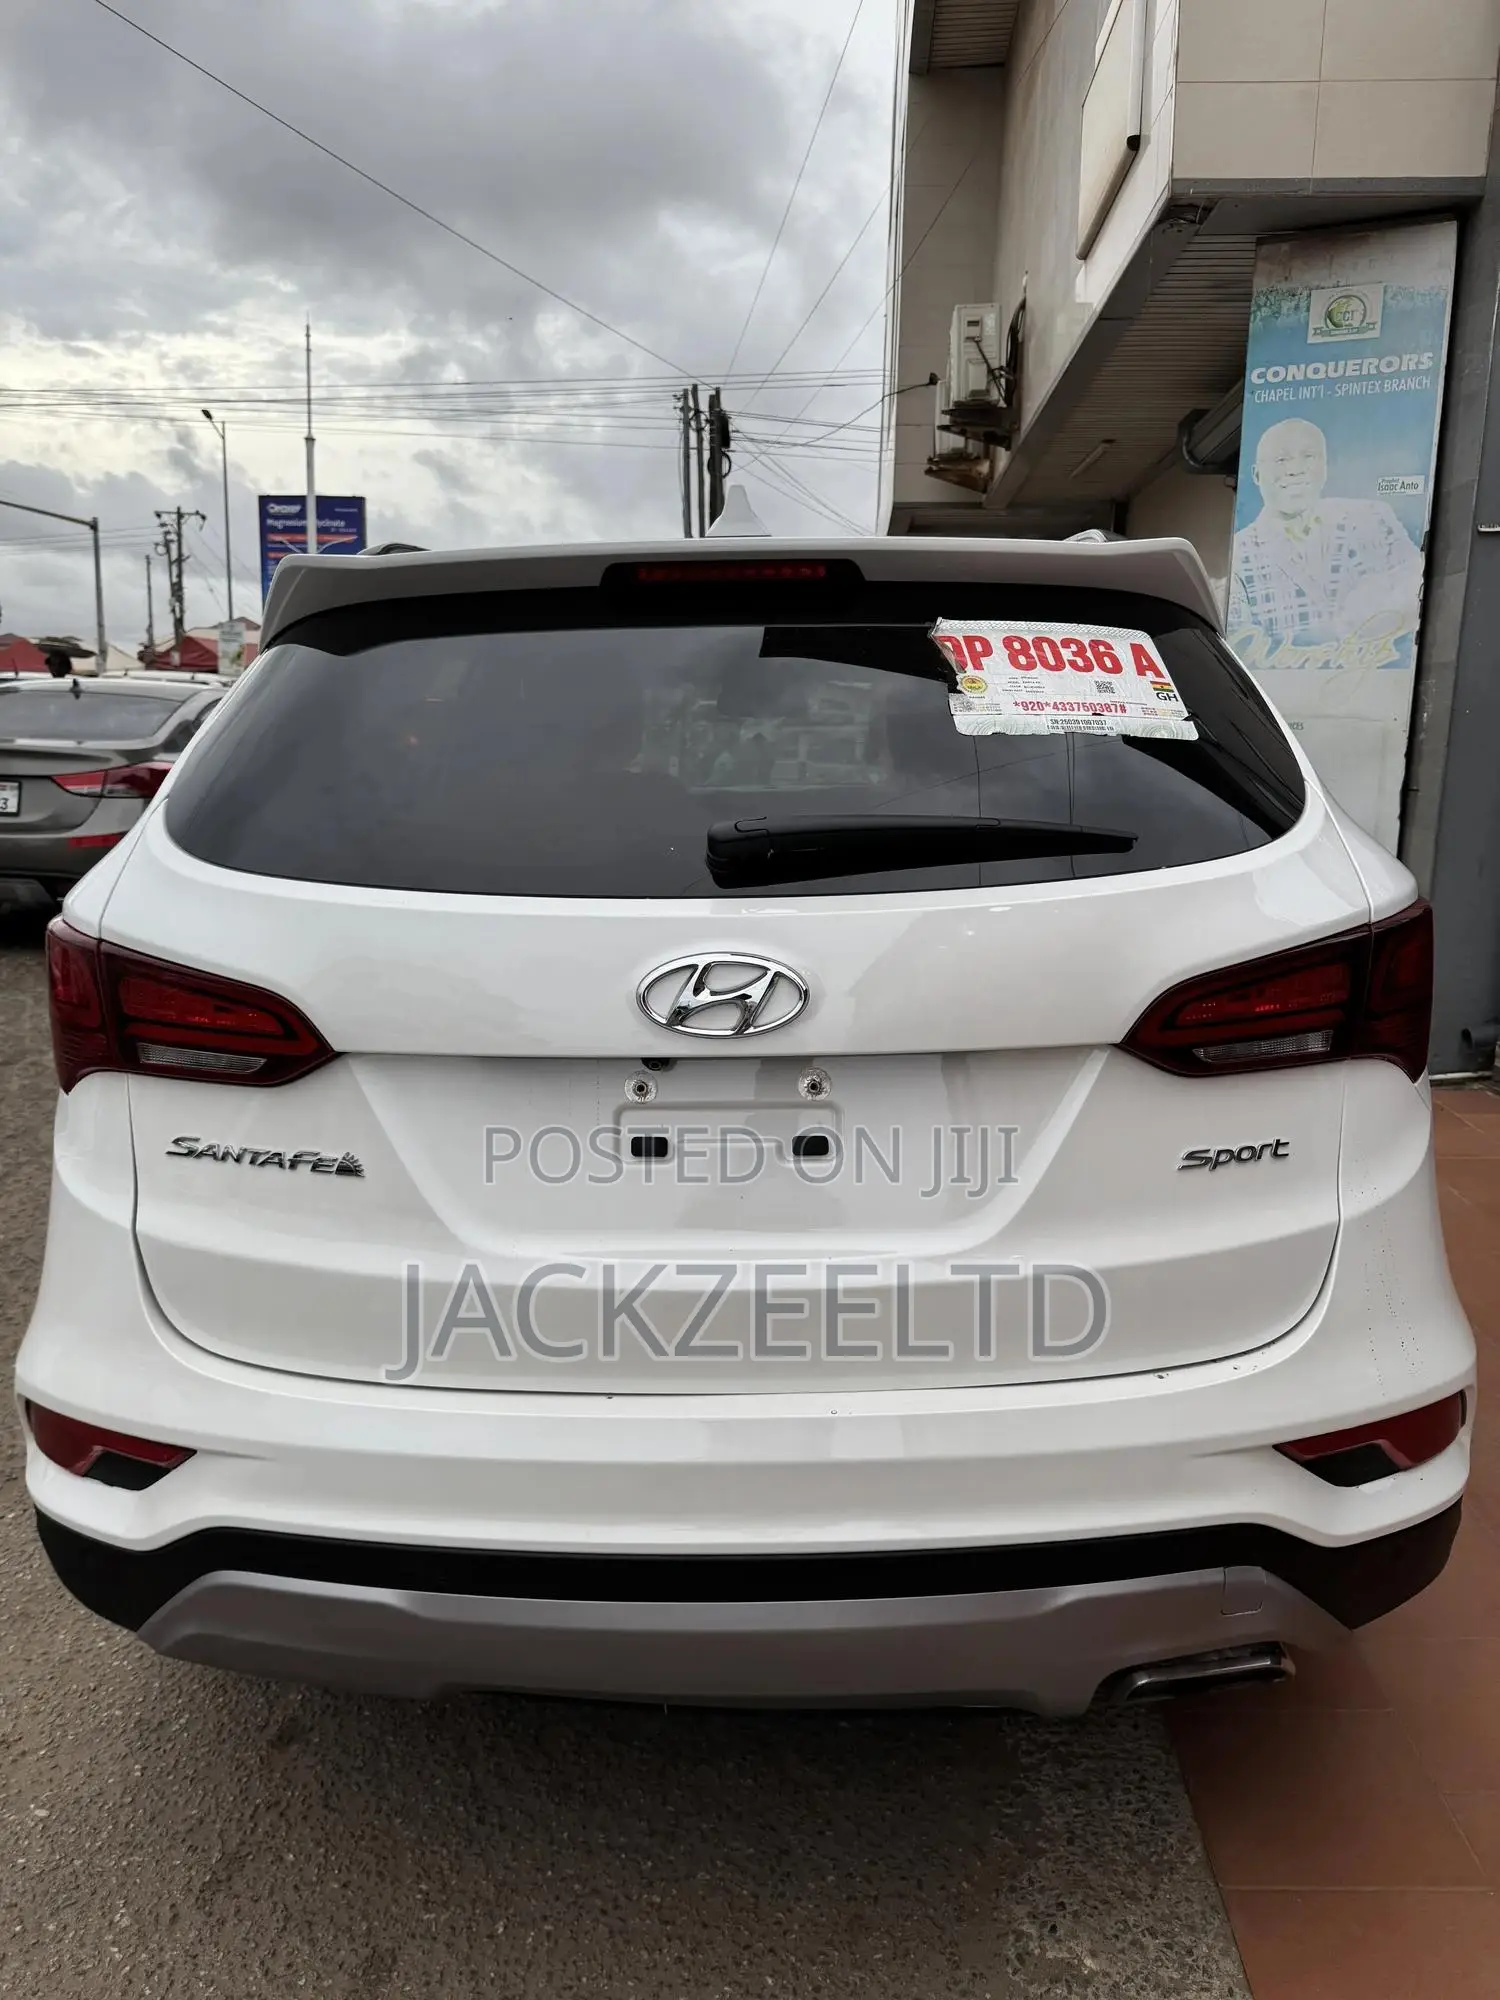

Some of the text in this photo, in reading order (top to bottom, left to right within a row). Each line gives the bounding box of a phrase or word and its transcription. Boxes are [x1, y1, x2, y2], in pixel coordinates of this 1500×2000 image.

[1250, 351, 1434, 385] CONQUERORS
[1254, 387, 1297, 403] CHAPEL
[1335, 379, 1381, 397] SPINTEX
[1384, 376, 1431, 393] BRANCH
[1400, 480, 1419, 490] Anto
[1002, 635, 1123, 675] 8036
[1129, 642, 1165, 679] A
[1155, 691, 1179, 702] GH
[1177, 1138, 1290, 1172] Sport
